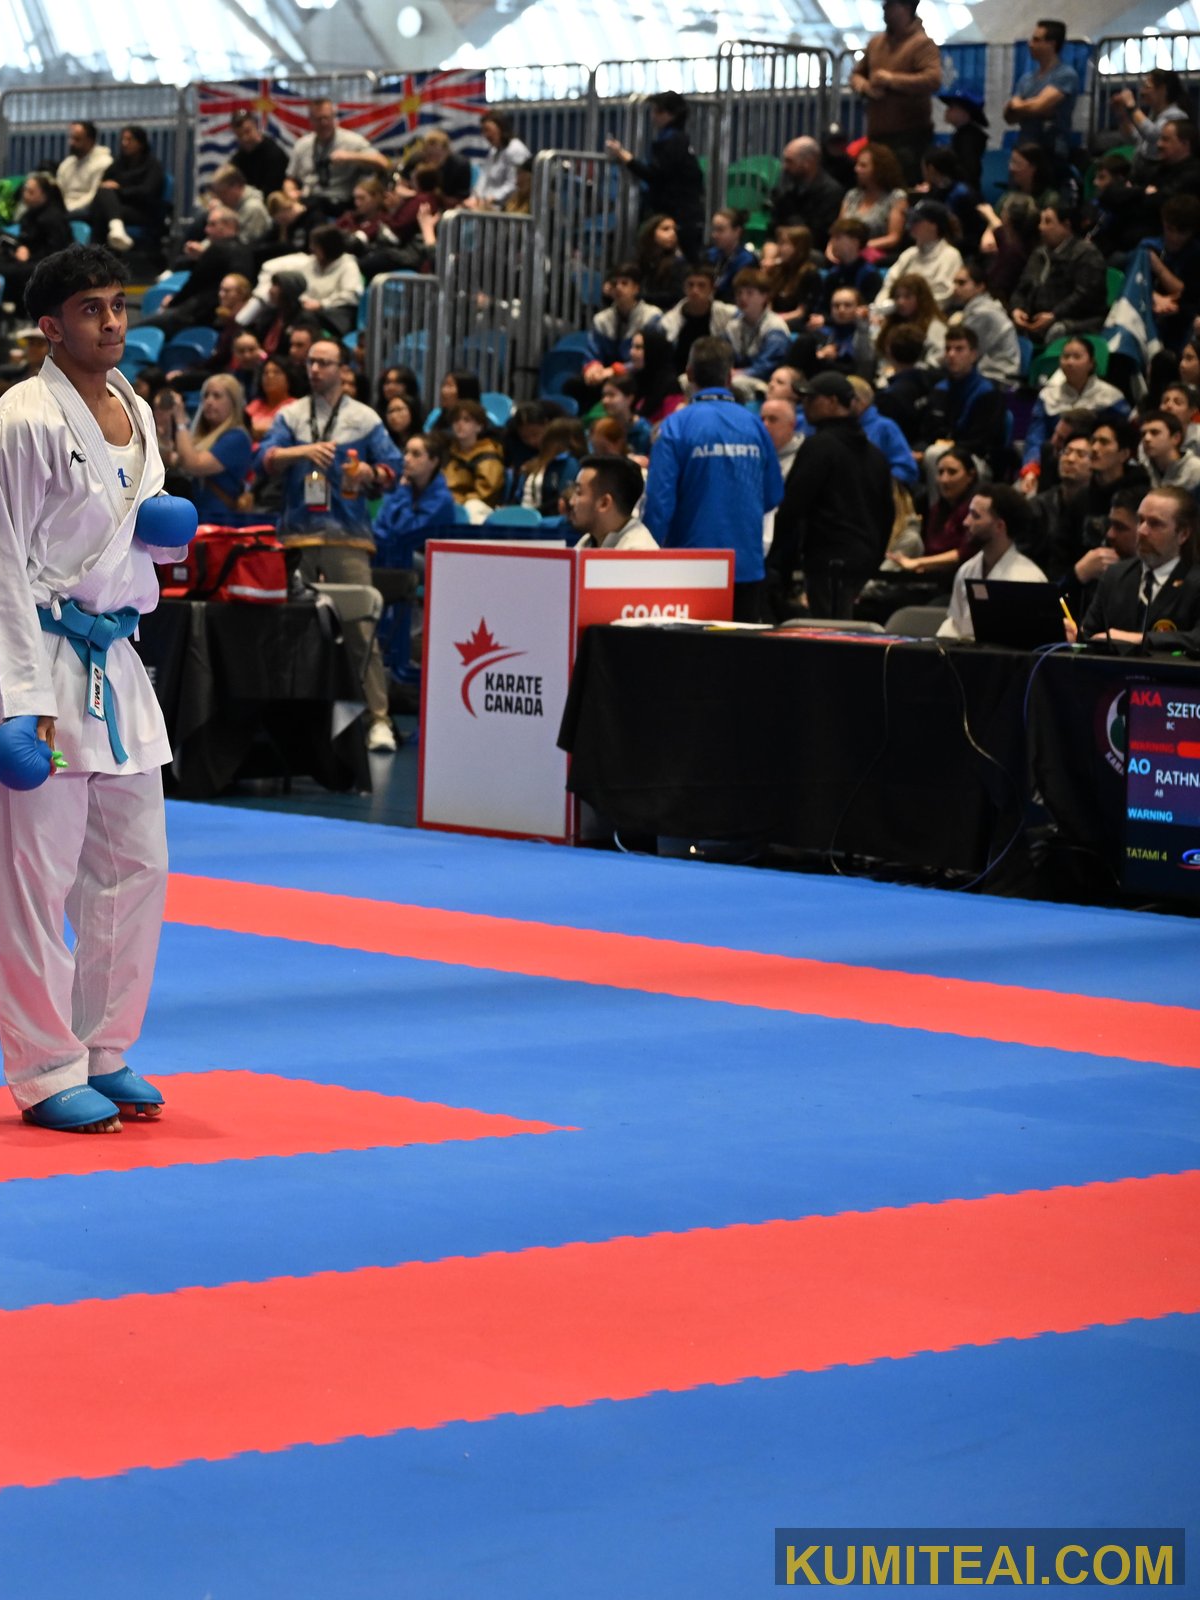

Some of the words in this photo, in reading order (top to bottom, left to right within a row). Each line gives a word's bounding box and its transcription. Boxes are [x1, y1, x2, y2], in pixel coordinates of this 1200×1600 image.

[692, 443, 760, 459] ALBERT
[621, 604, 689, 620] COACH
[485, 672, 542, 696] KARATE
[484, 694, 544, 717] CANADA
[1130, 691, 1162, 707] AKA
[1128, 757, 1151, 775] AO
[1155, 769, 1200, 788] RATHN
[1127, 808, 1173, 822] WARNING
[1126, 847, 1159, 860] TATAMI
[1161, 852, 1167, 861] 4
